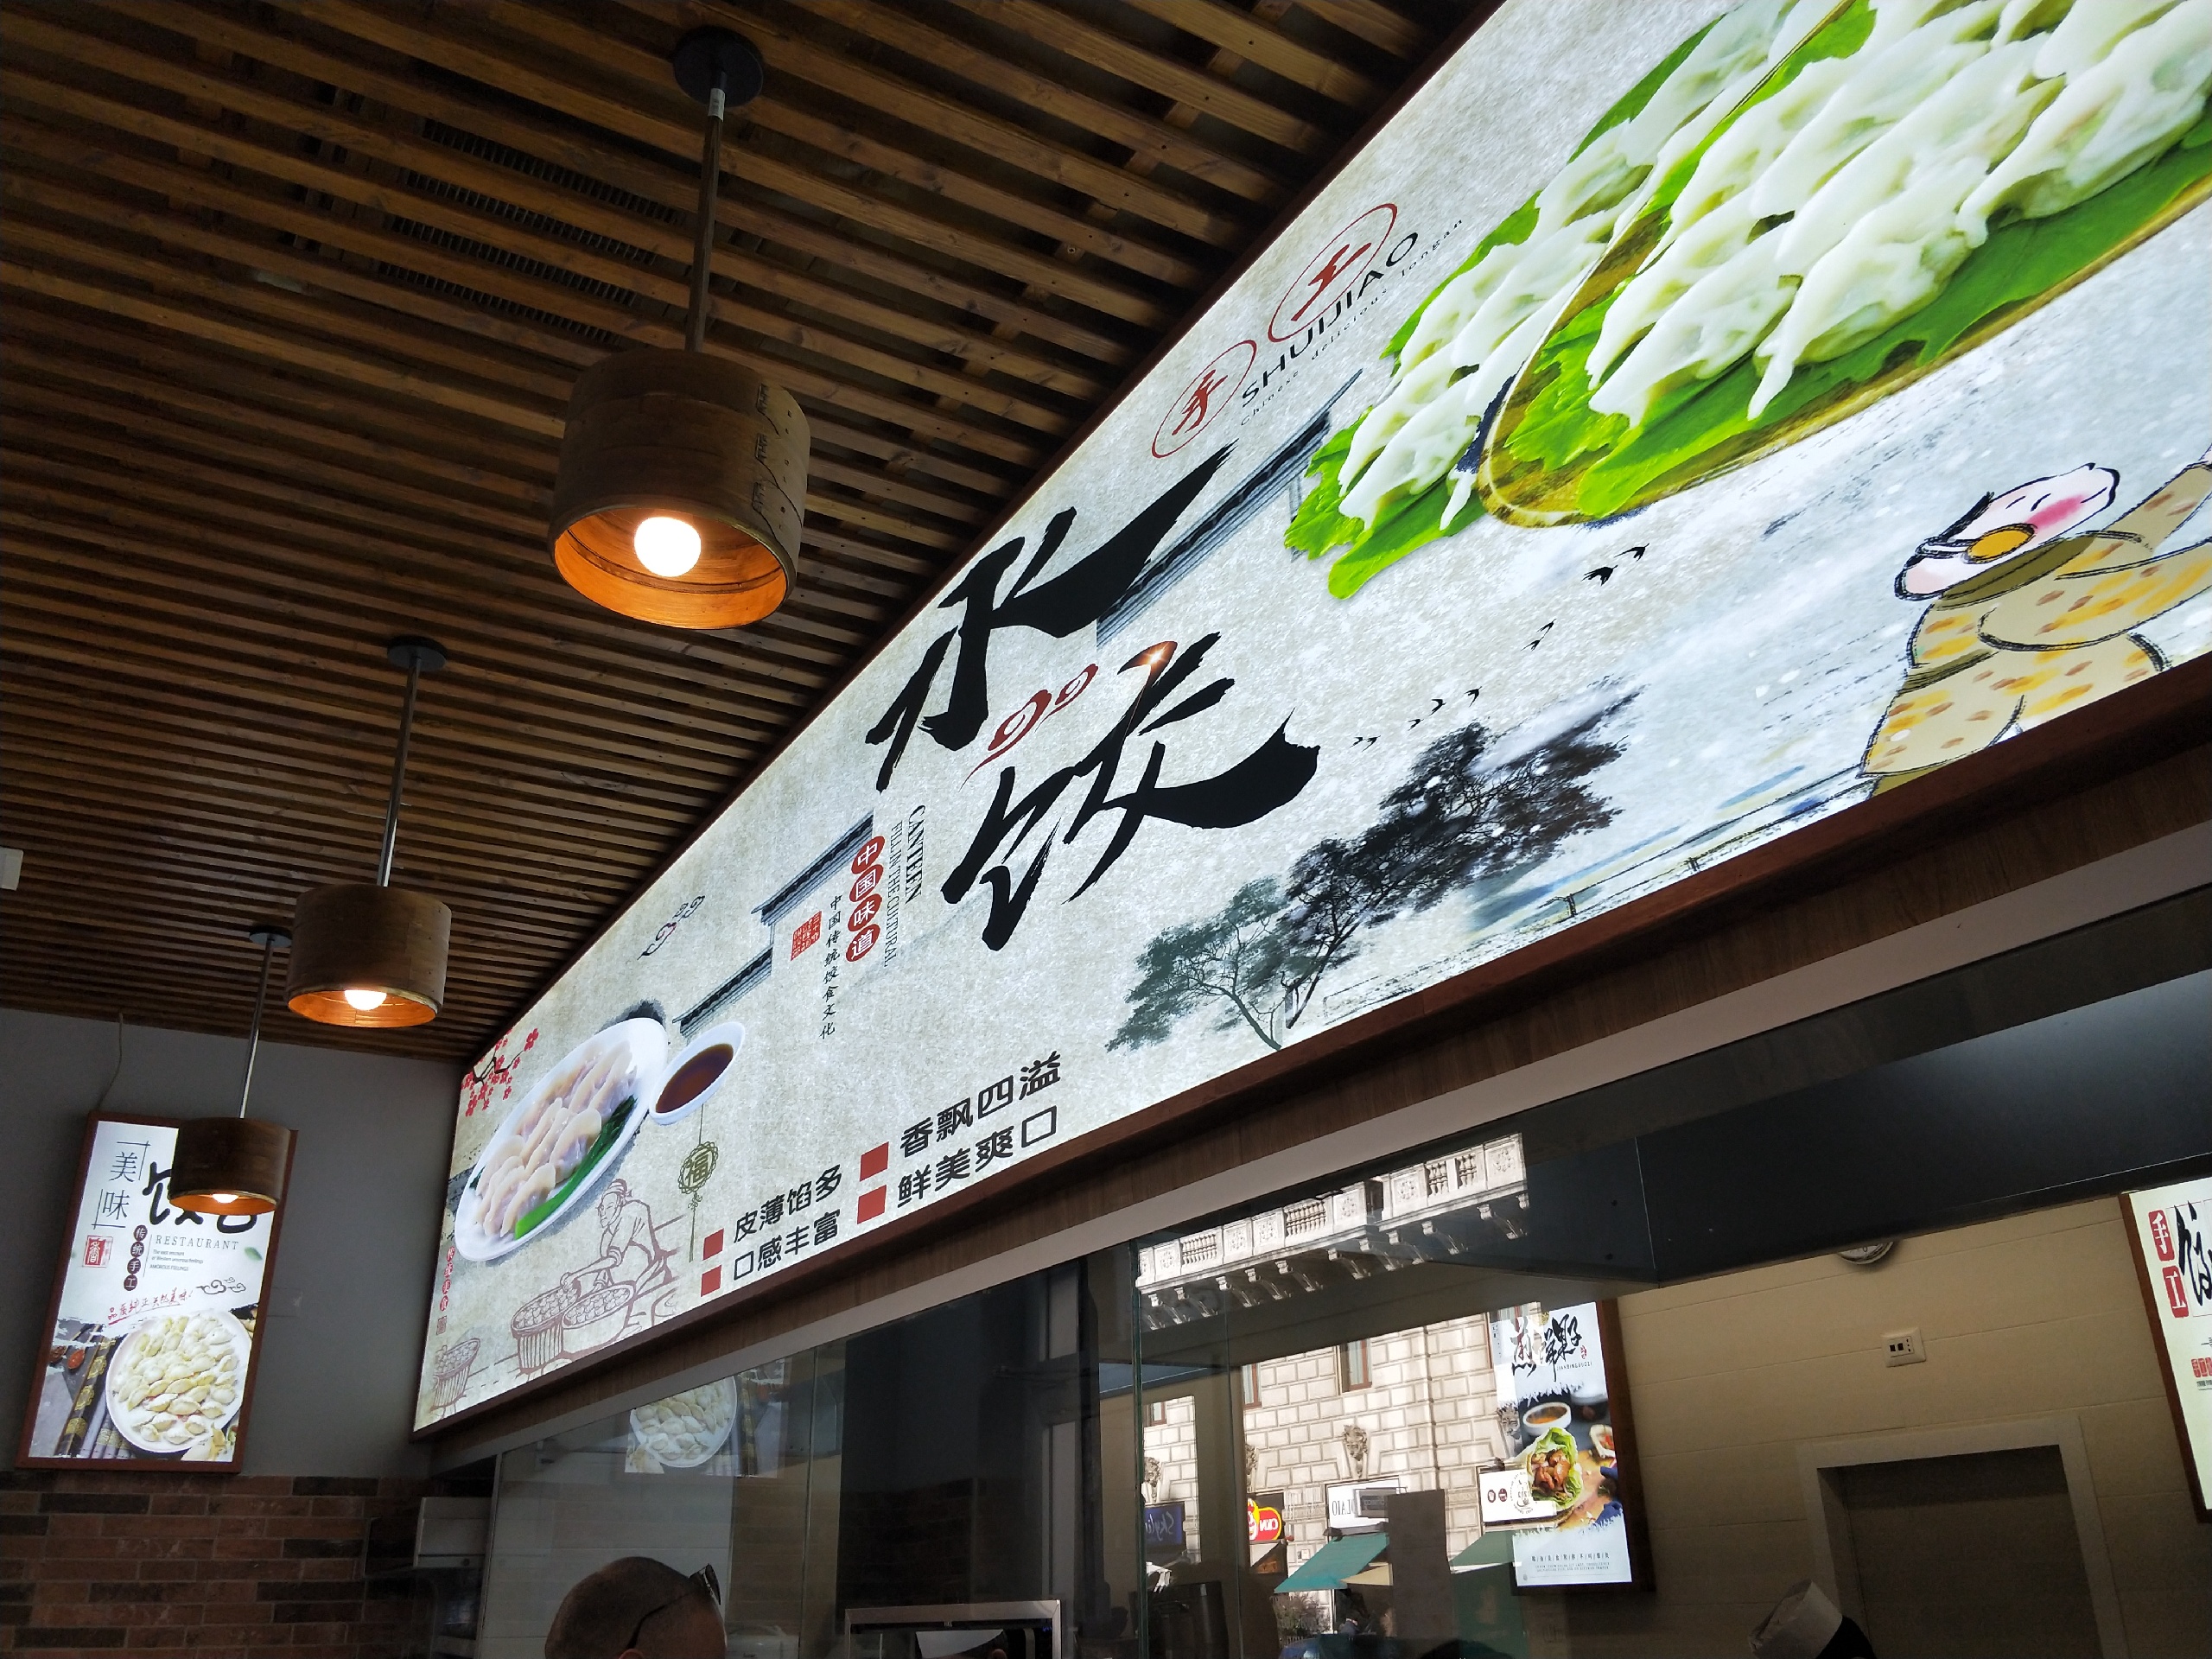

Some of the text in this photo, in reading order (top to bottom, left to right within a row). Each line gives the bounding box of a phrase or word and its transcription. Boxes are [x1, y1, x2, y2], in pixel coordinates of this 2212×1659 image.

[1240, 219, 1463, 426] Chinese delicious longan
[1242, 232, 1419, 409] SHUIJIAO
[865, 438, 1320, 951] 水饺
[848, 838, 882, 962] 中国味道
[884, 820, 903, 968] FILL IN THE CULTURAL
[905, 804, 926, 906] CANTEEN
[899, 1050, 1061, 1158] 香飘四溢
[102, 1151, 138, 1221] 美味
[733, 1164, 842, 1244] 皮薄馅多
[897, 1106, 1058, 1208] 鲜美爽口
[125, 1225, 147, 1290] 传统手工
[156, 1235, 239, 1250] RESTAURANT
[733, 1209, 841, 1281] 口感丰富
[2152, 1211, 2187, 1310] 手工
